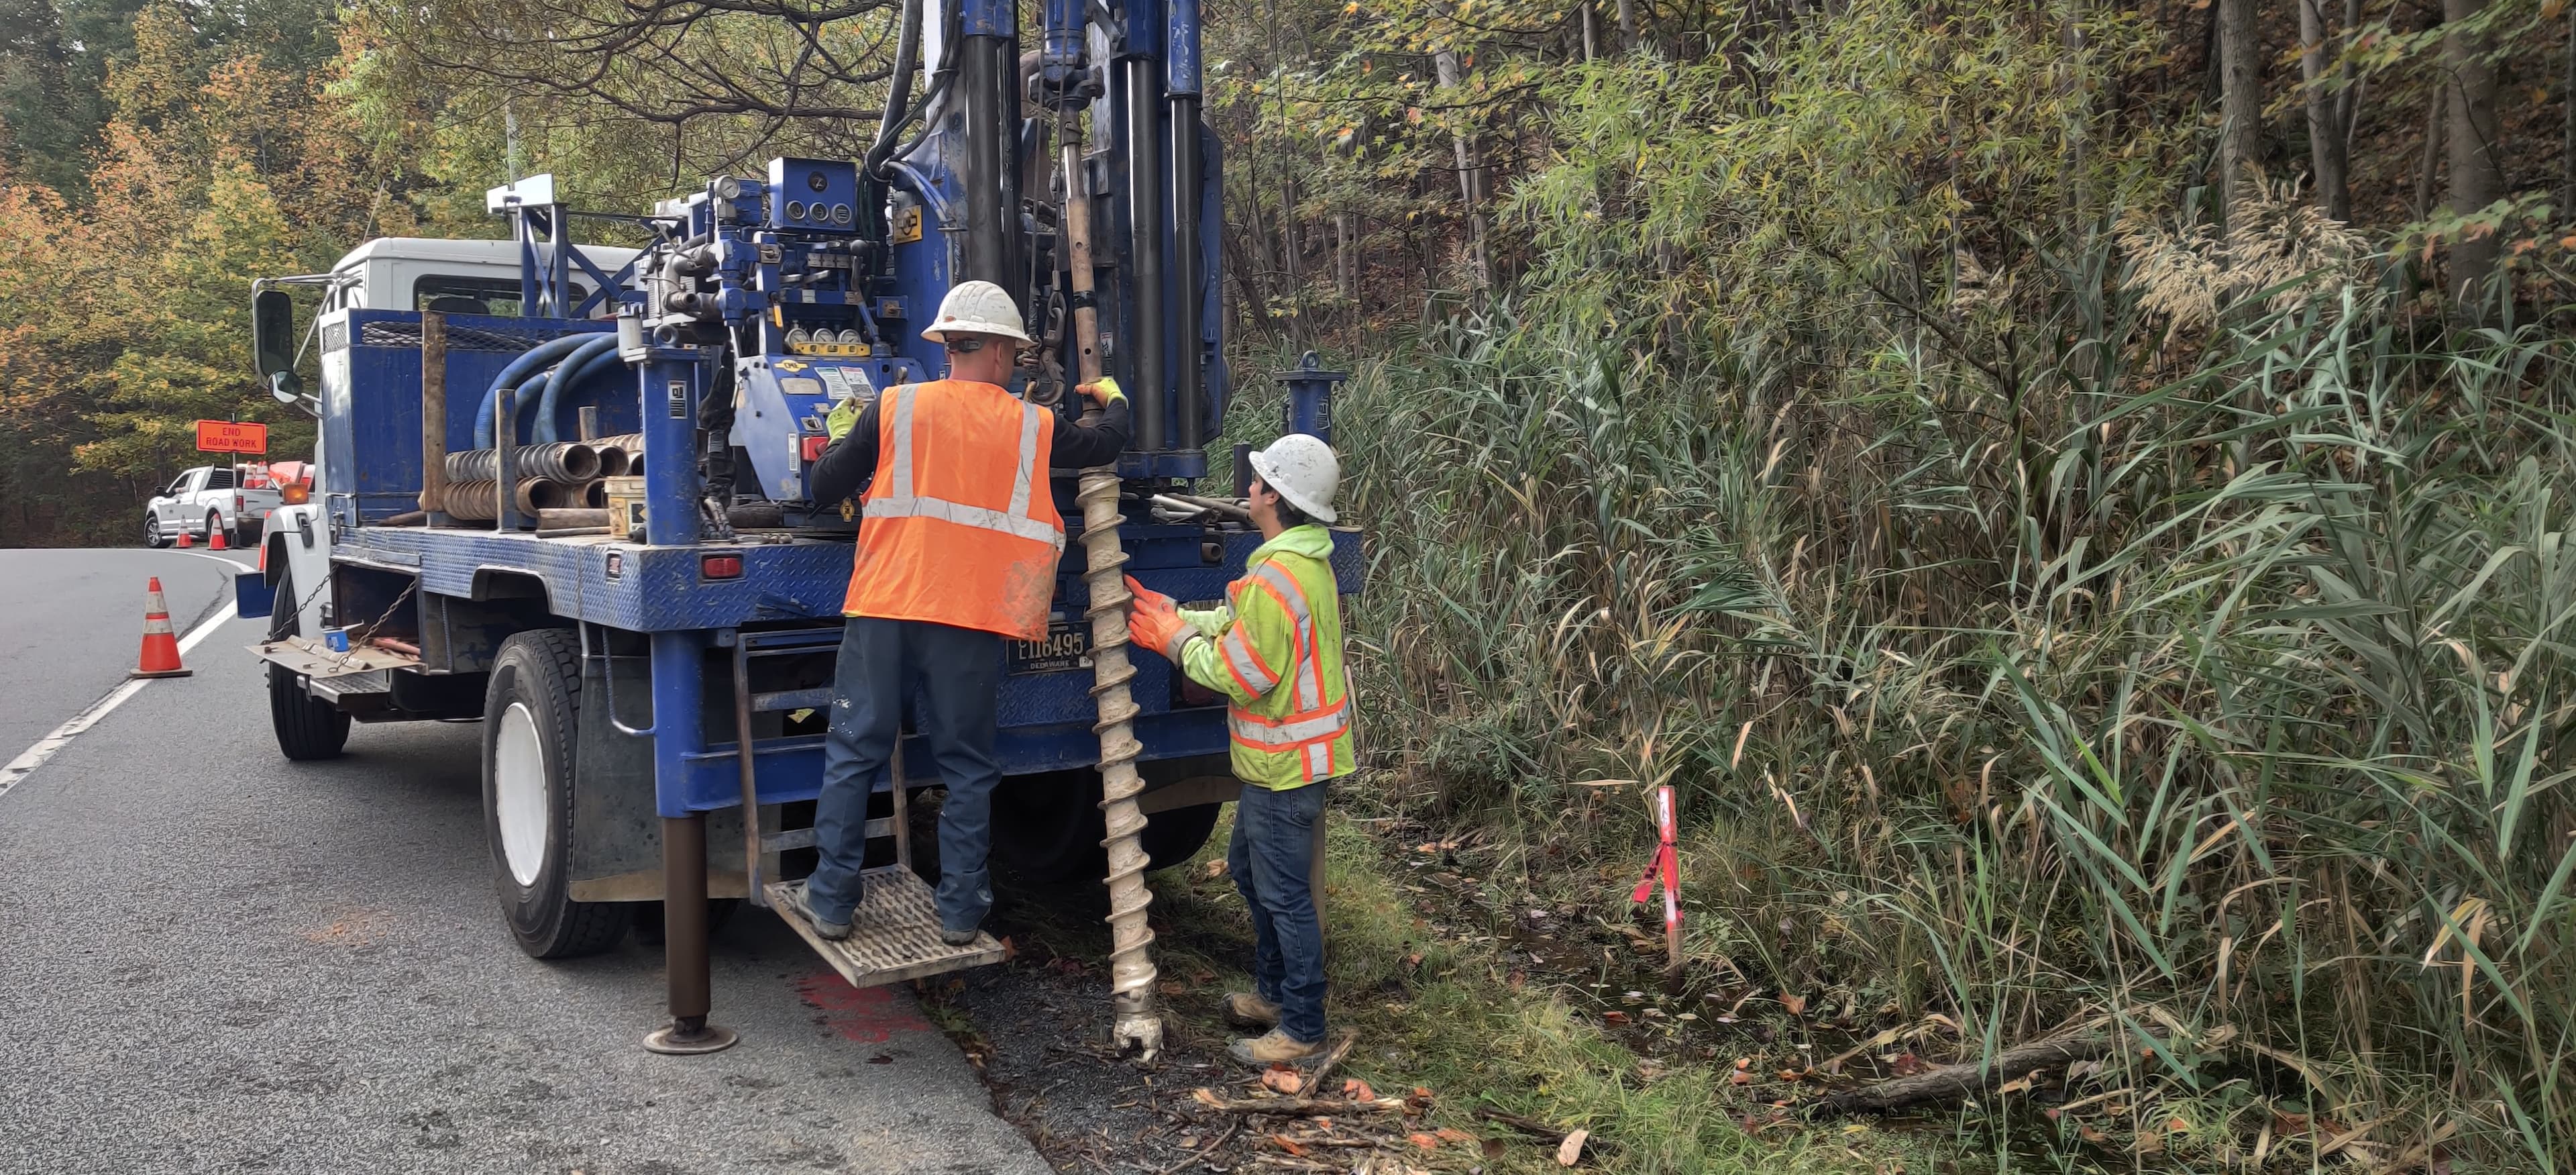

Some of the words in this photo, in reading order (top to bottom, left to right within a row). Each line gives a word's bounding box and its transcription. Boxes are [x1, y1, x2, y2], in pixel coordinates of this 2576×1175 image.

[222, 427, 241, 436] END
[206, 437, 229, 446] ROAD
[232, 438, 257, 448] WORK
